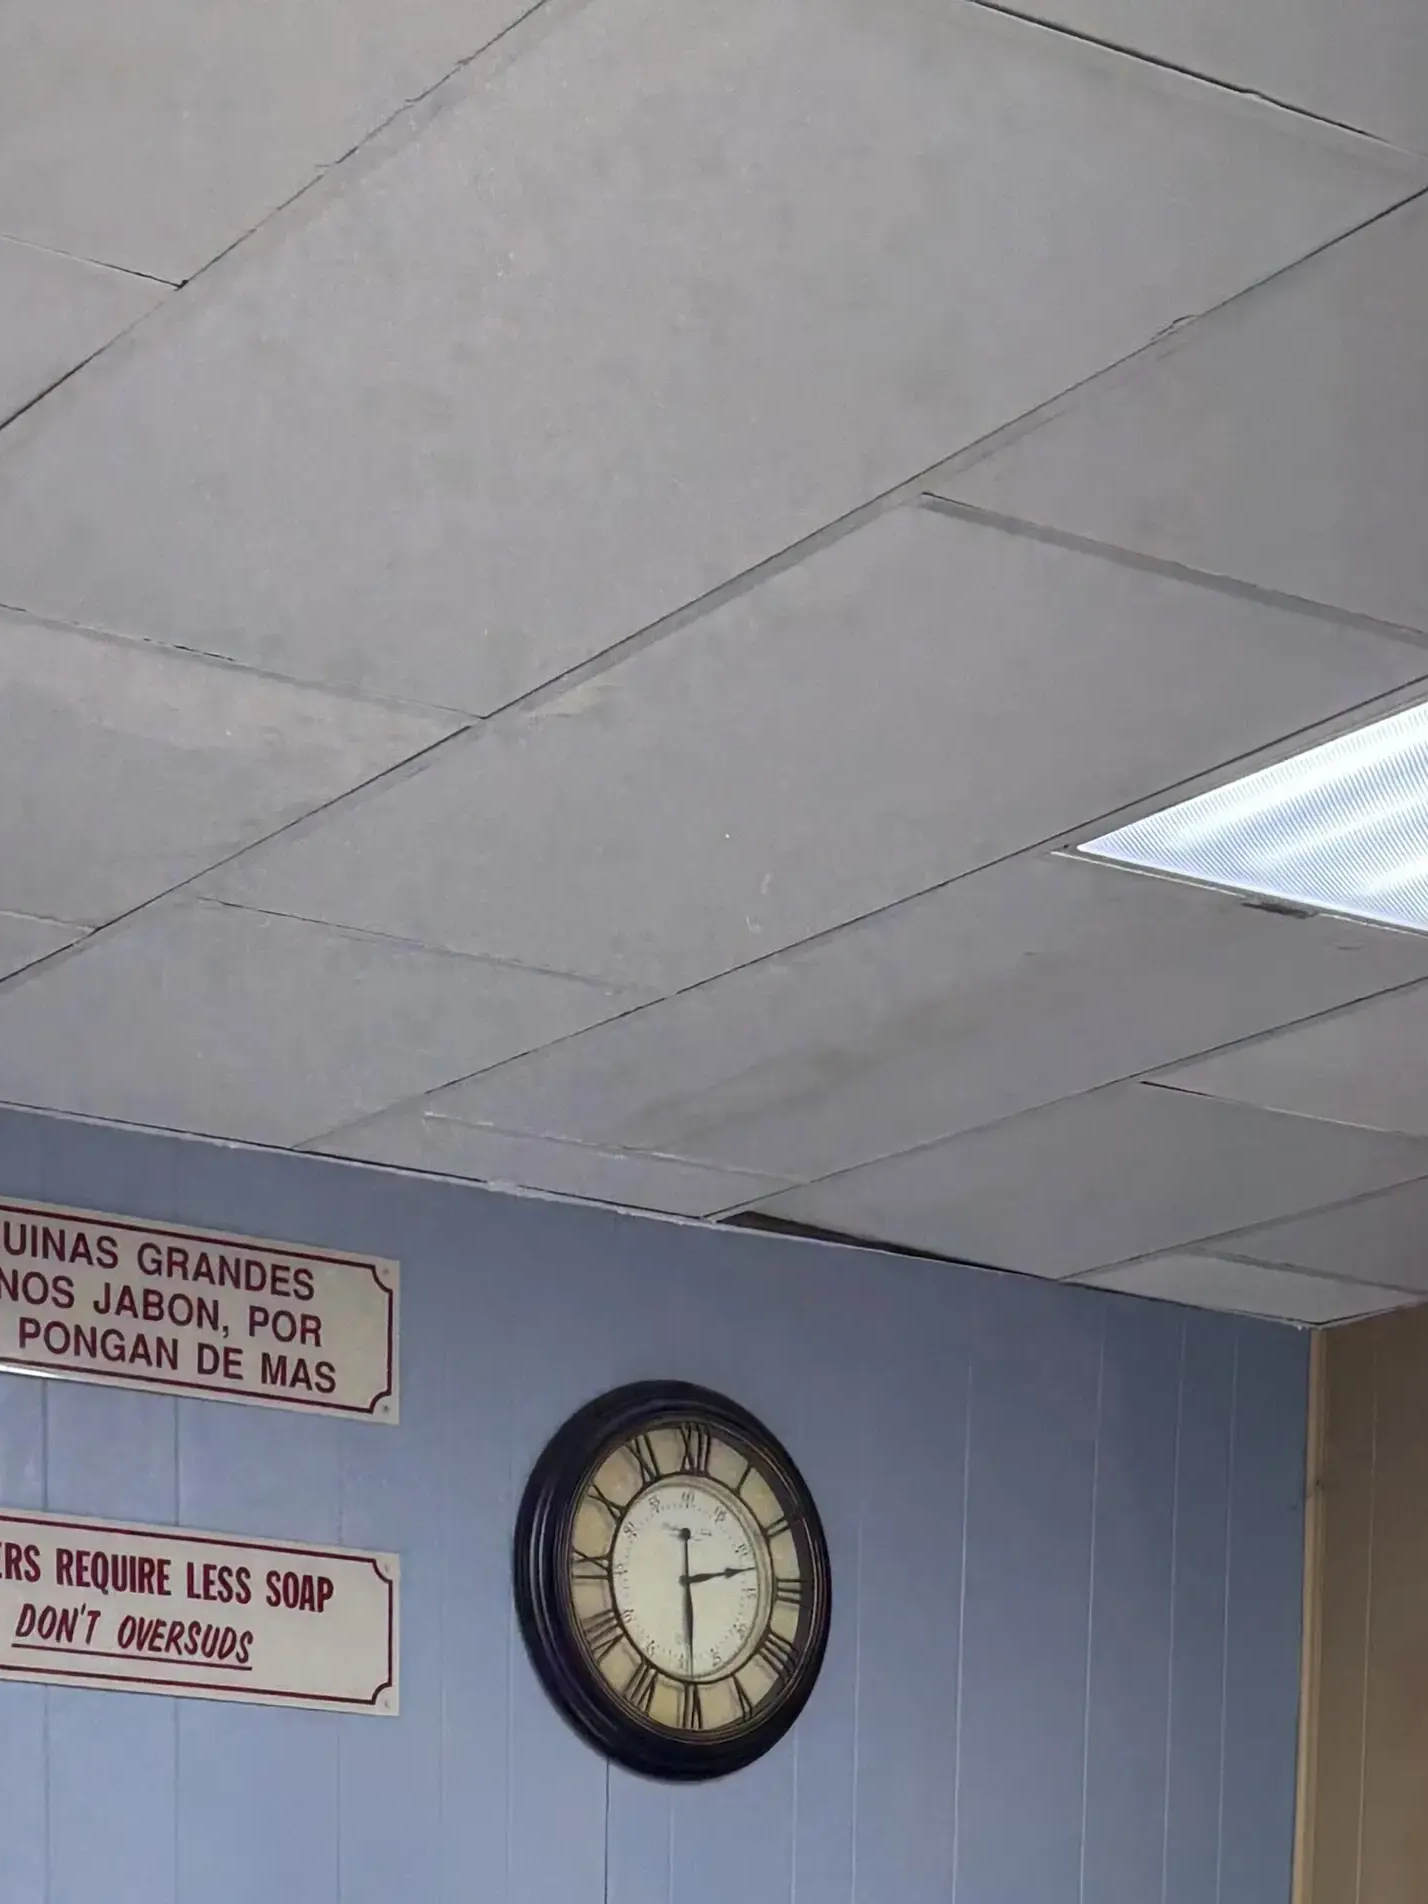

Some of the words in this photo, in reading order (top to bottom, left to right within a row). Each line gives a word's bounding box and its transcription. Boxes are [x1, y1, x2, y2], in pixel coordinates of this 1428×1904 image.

[136, 1241, 315, 1302] GRANDES
[92, 1283, 230, 1339] JABON,
[247, 1304, 322, 1349] POR
[18, 1319, 178, 1371] PONGAN
[196, 1342, 244, 1381] DE
[260, 1353, 336, 1394] MAS
[56, 1547, 172, 1597] REQUIRE
[186, 1561, 252, 1605] LESS
[265, 1571, 334, 1613] SOAP
[14, 1602, 102, 1646] DON'T
[117, 1614, 254, 1664] OVERSUDS
